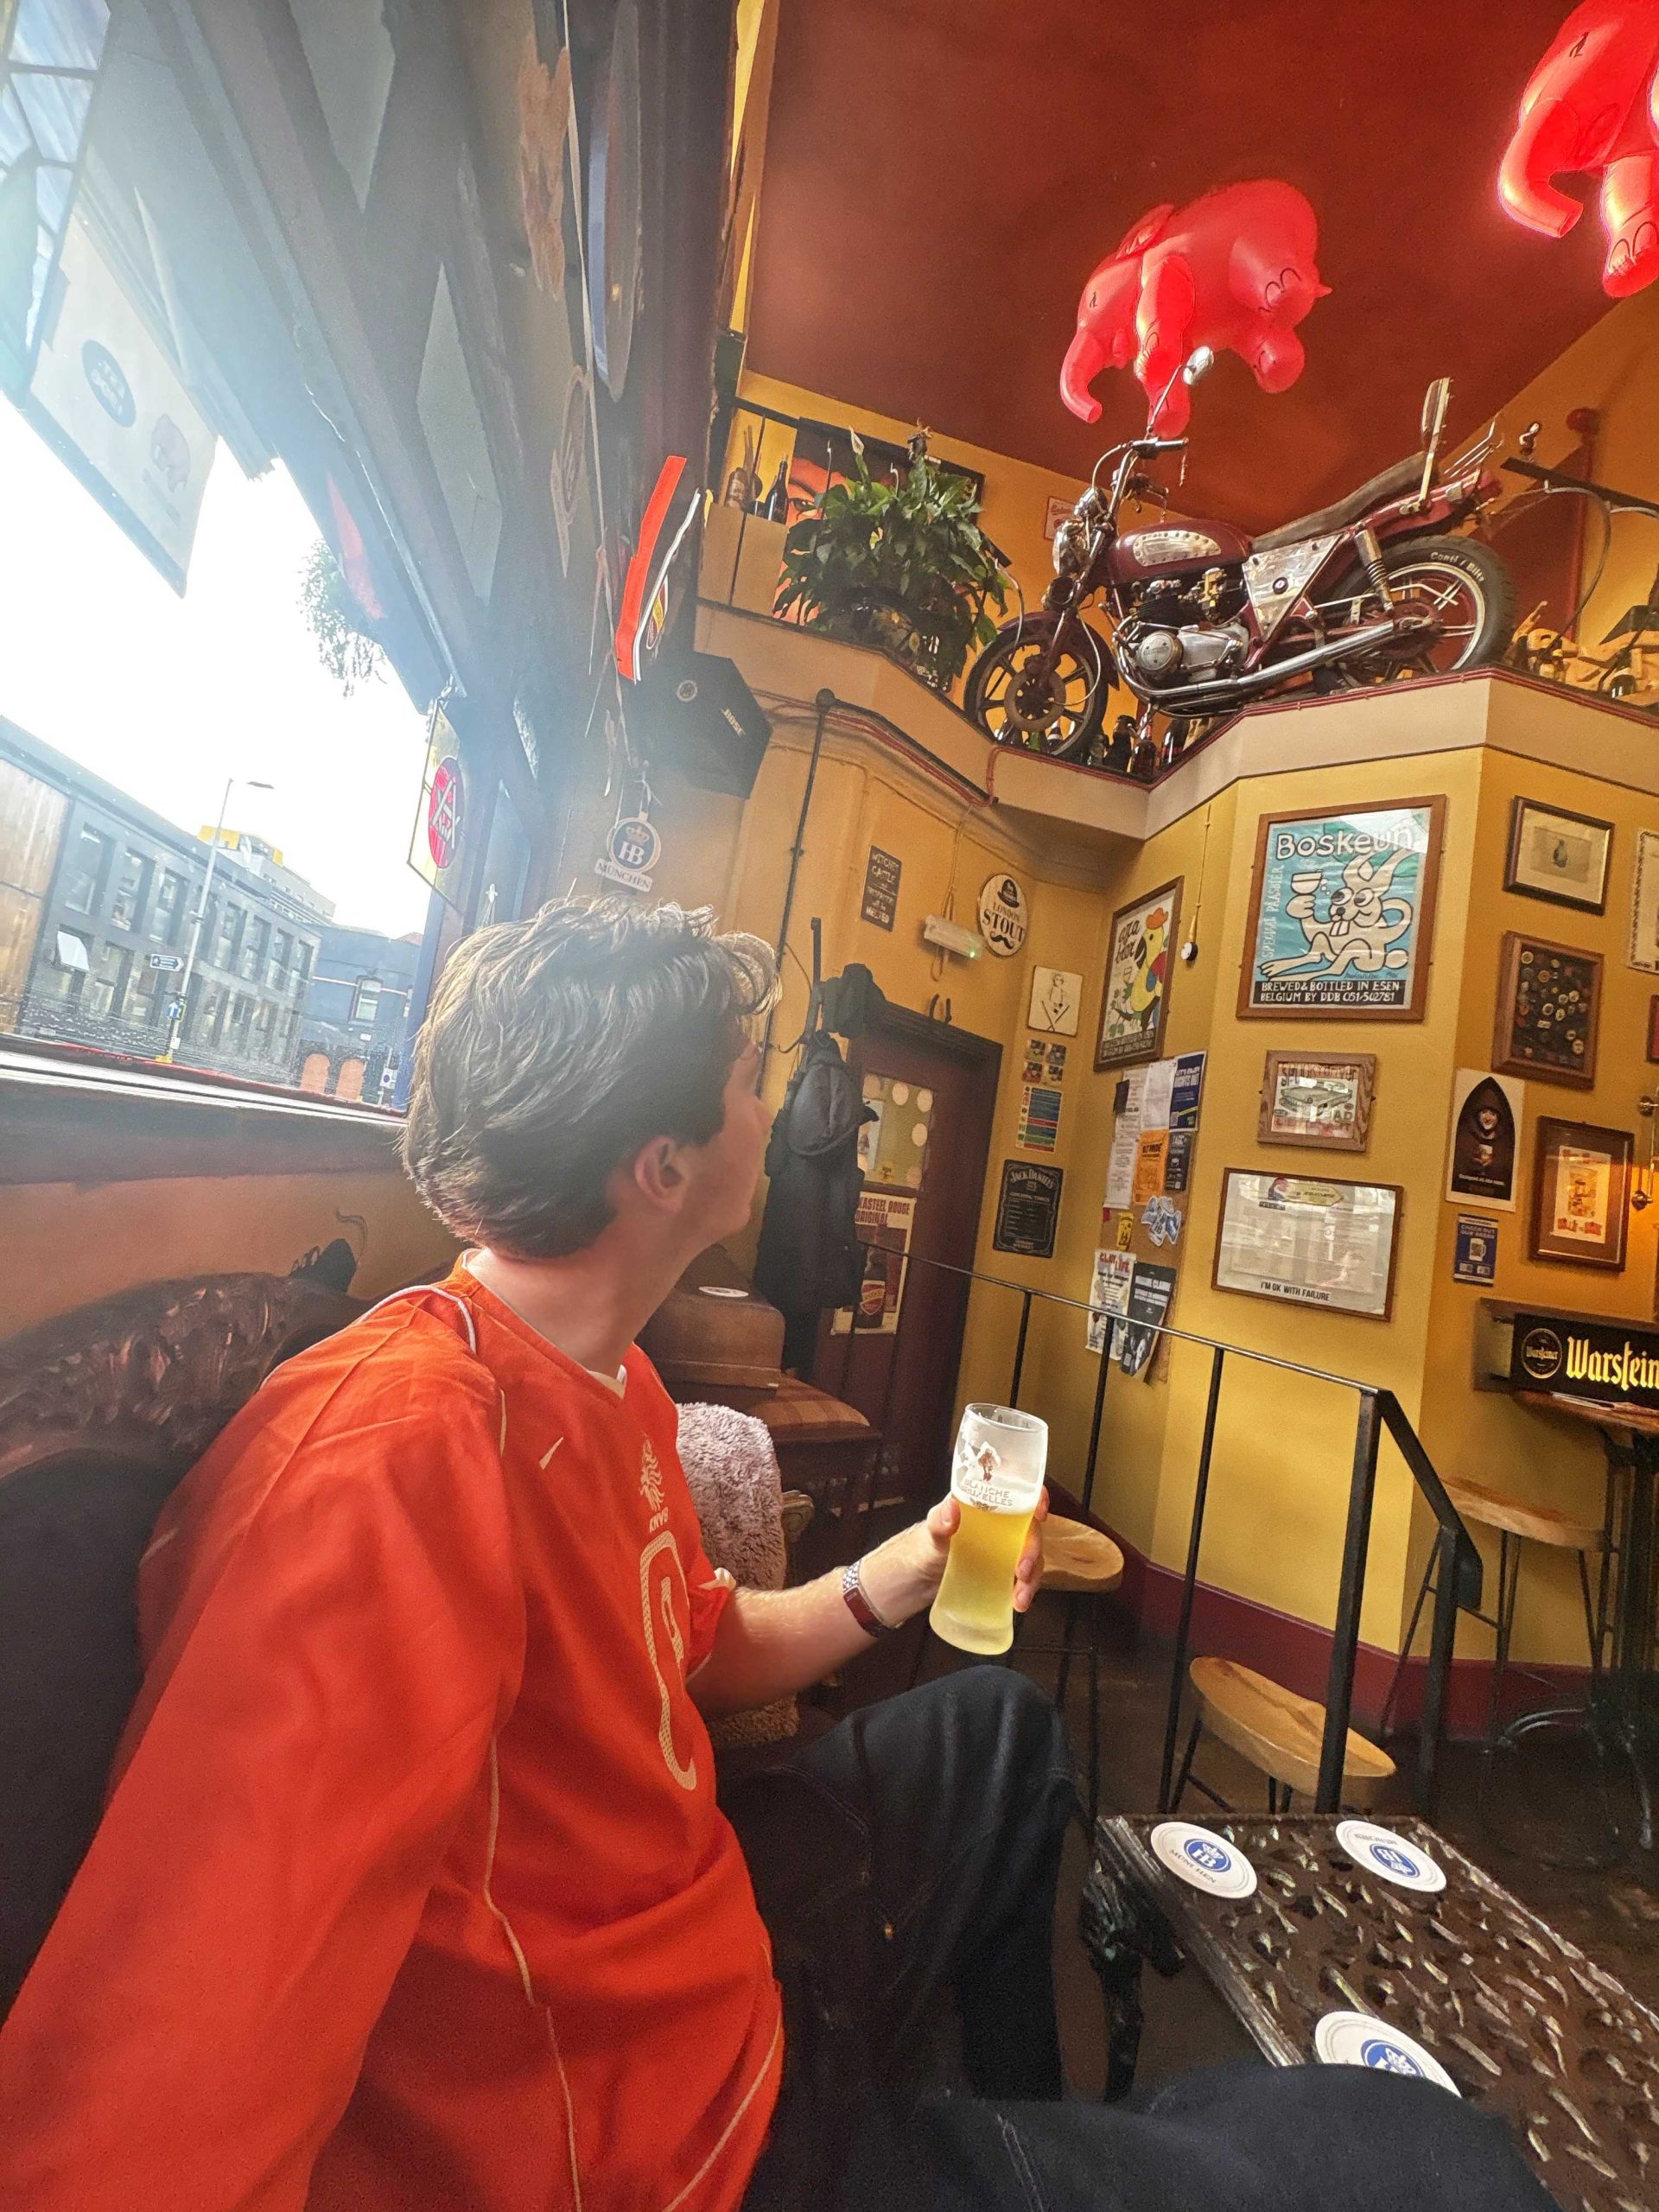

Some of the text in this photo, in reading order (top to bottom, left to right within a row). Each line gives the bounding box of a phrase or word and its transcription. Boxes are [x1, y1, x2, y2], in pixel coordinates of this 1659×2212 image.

[618, 840, 645, 865] HB
[1274, 827, 1414, 861] Boskeun
[982, 908, 1026, 943] STOUT
[1260, 992, 1301, 1001] BELGIUM
[1304, 992, 1316, 1001] BY
[1320, 992, 1340, 1001] DDB
[1357, 981, 1370, 991] IN
[1372, 981, 1400, 991] ESEN
[1261, 1281, 1331, 1301] I'M OK WITH FAILURE
[649, 1506, 669, 1534] KNVB
[1192, 1848, 1217, 1867] HB
